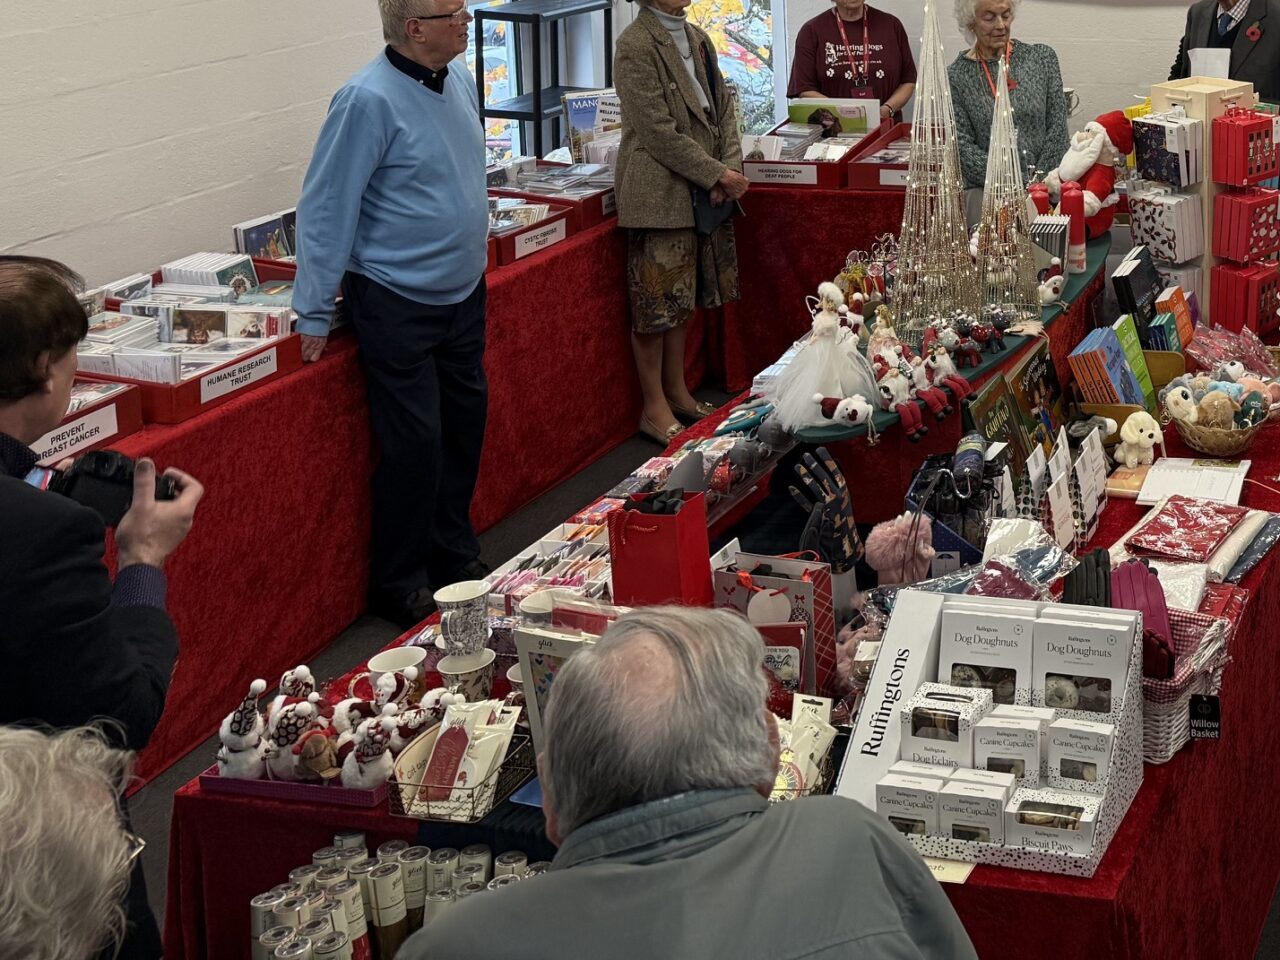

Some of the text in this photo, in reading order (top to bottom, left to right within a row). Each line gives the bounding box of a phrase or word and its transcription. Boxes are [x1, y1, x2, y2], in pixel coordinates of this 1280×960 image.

[524, 234, 540, 244] CYSTIC
[536, 238, 548, 247] TRUST
[207, 354, 271, 387] HUMANE RESEARCH
[230, 372, 252, 387] TRUST
[50, 423, 85, 445] PREVENT
[69, 426, 100, 447] CANCER
[954, 633, 1018, 648] Dog Doughnuts
[1047, 642, 1112, 658] Dog Doughnuts
[861, 648, 910, 757] Ruffingtons
[1191, 719, 1219, 728] Willow
[1191, 729, 1219, 738] Basket
[980, 738, 1035, 749] Canine Cupcakes
[1053, 738, 1106, 753] Canine Cupcakes
[912, 753, 959, 767] Dog Eclairs
[879, 796, 933, 810] Canine Cupcakes
[942, 804, 997, 817] Canine Cupcakes
[1021, 837, 1074, 851] Biscuit Paws
